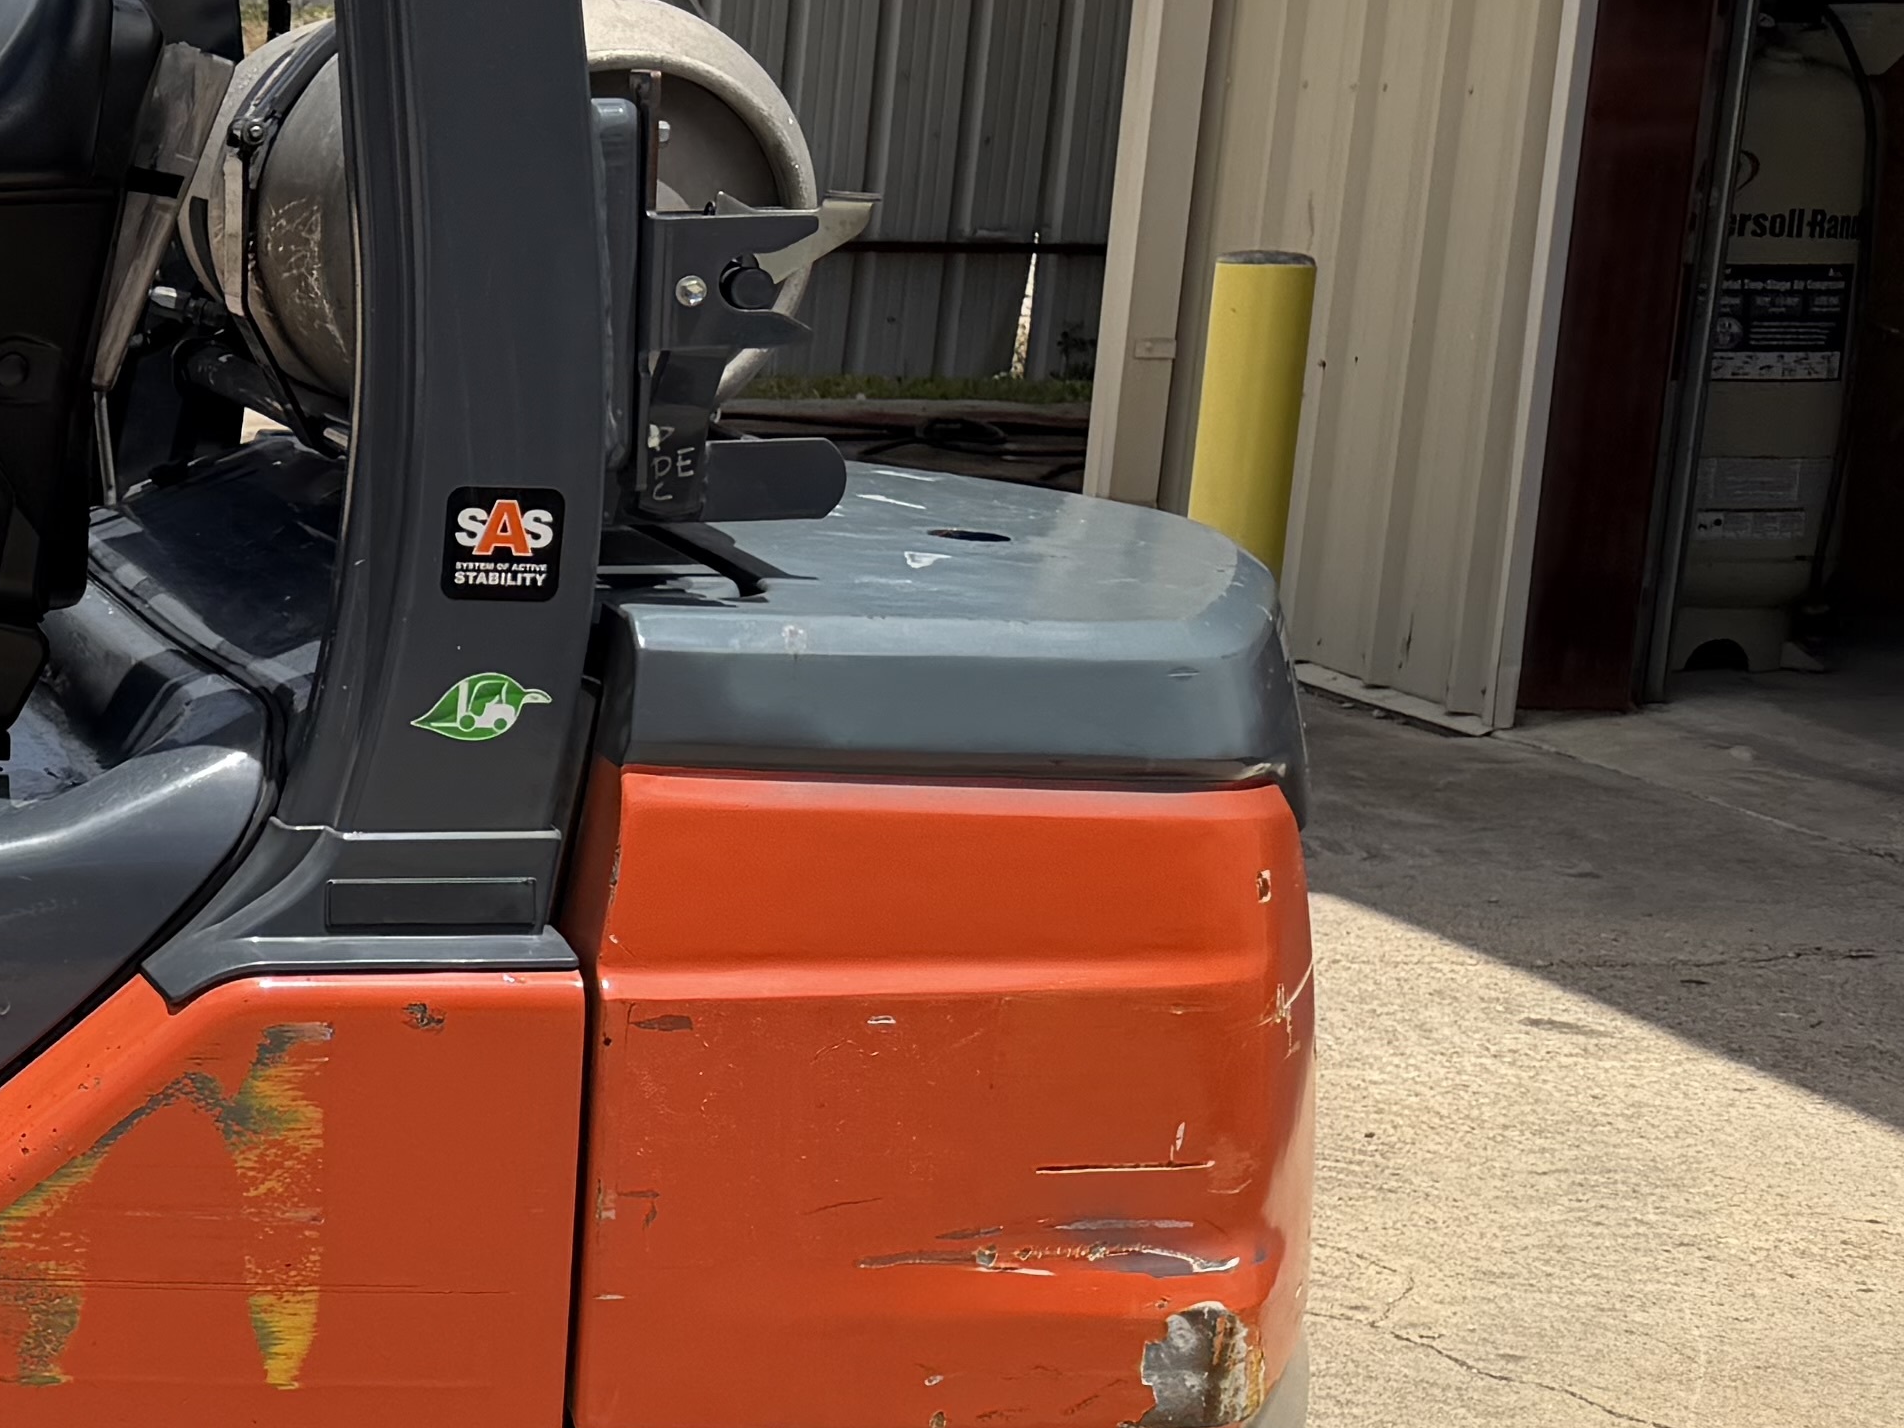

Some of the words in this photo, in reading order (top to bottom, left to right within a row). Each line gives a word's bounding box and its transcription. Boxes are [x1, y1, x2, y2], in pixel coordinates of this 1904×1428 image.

[454, 499, 554, 557] SAS
[455, 561, 495, 570] SYSTEM
[496, 562, 510, 571] OF
[511, 563, 548, 572] ACTIVE
[454, 570, 547, 587] STABILITY
